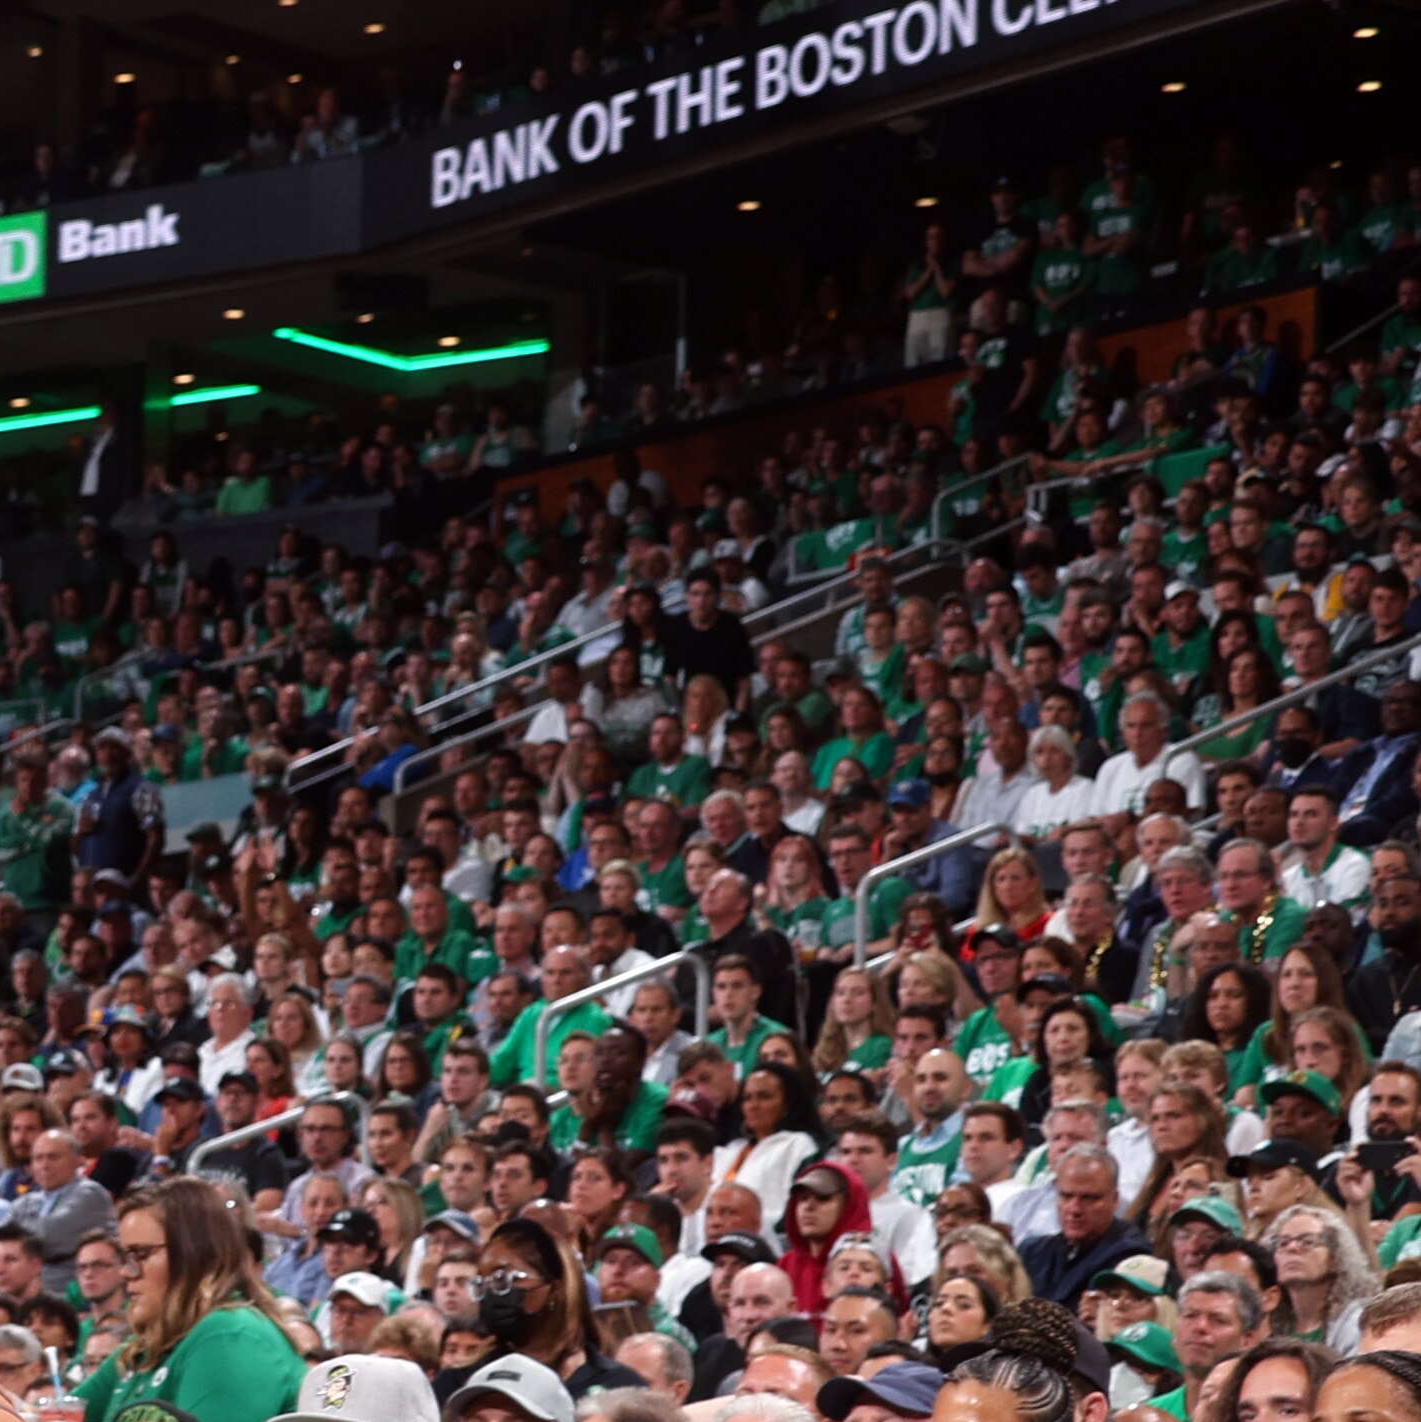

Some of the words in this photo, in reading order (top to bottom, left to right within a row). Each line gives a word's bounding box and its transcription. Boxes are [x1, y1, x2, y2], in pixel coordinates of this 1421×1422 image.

[432, 115, 561, 208] BANK
[568, 92, 636, 163] OF
[647, 57, 744, 140] THE
[757, 0, 978, 109] BOSTON
[59, 203, 181, 263] Bank
